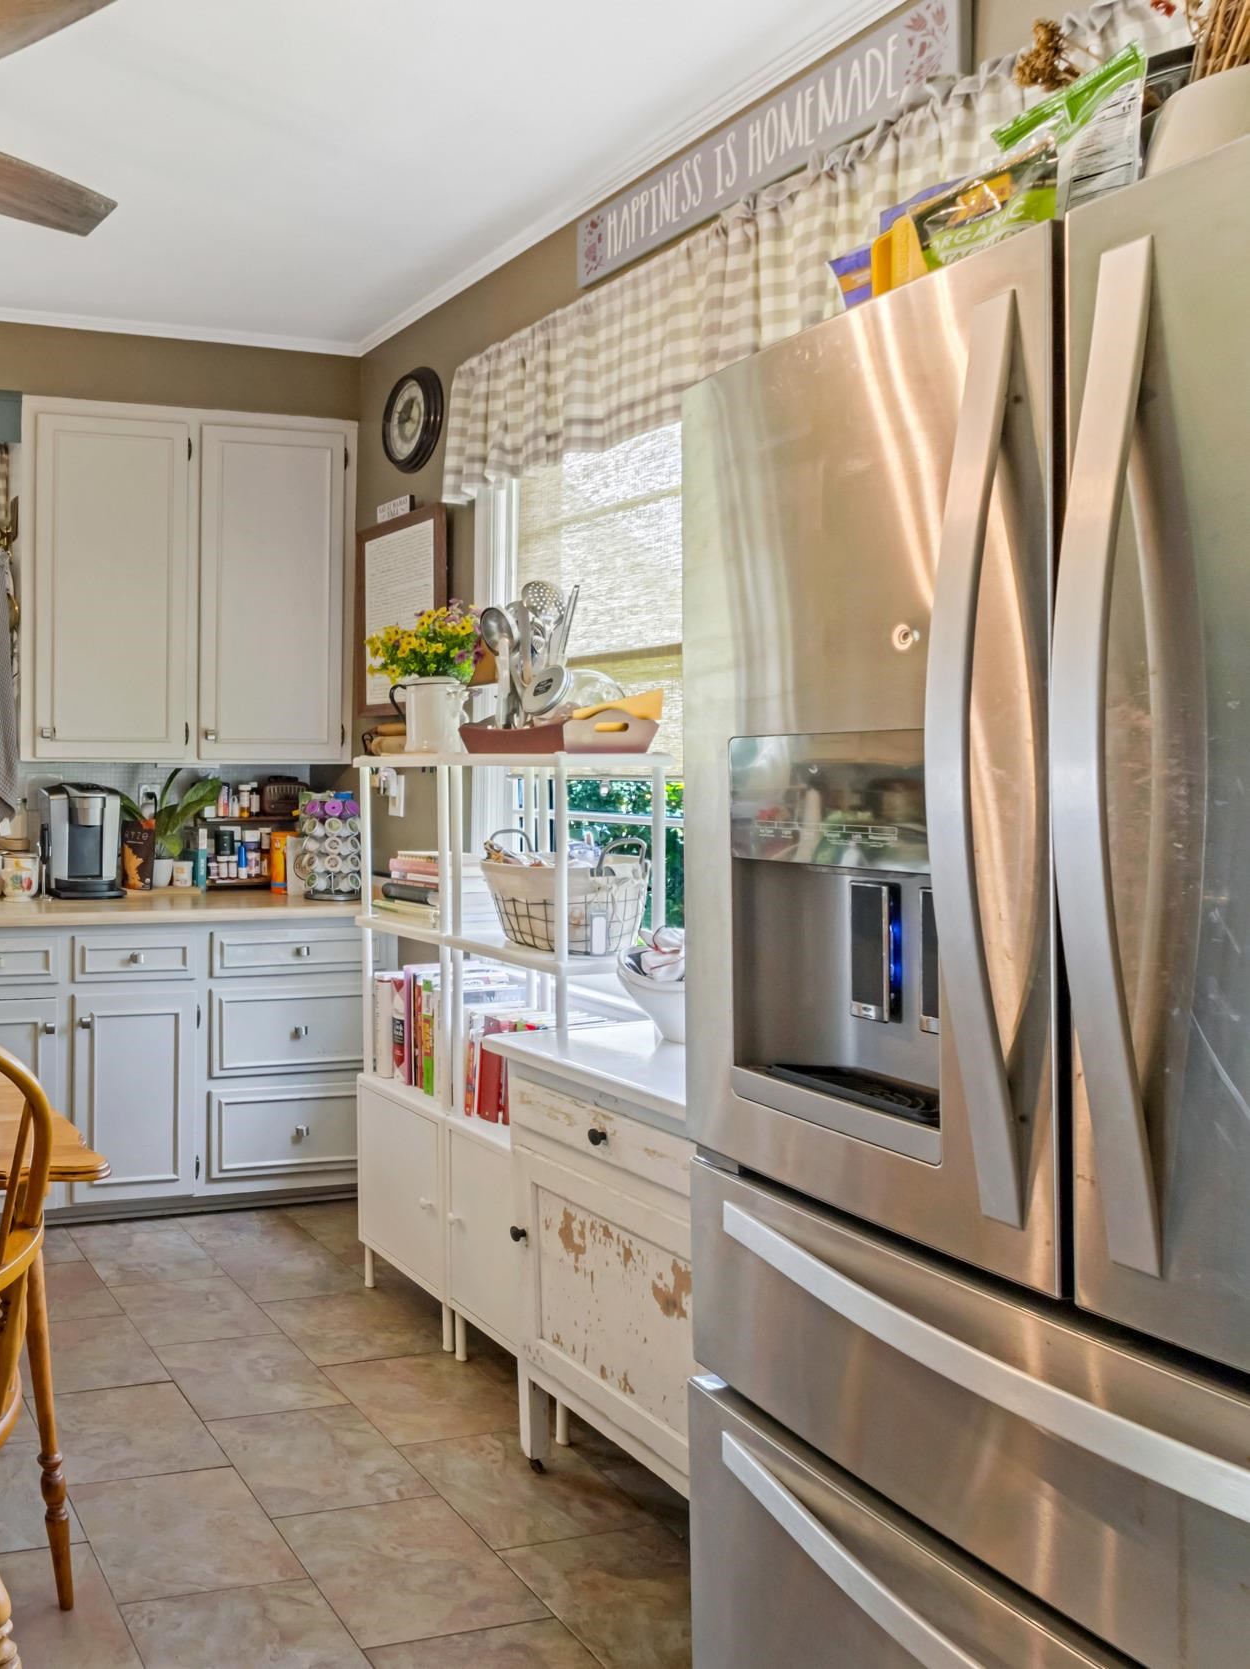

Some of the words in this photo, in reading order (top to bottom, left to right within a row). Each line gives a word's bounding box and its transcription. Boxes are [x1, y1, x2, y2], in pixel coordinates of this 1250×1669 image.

[606, 152, 703, 260] HAPPINESS
[714, 130, 737, 199] IS
[747, 33, 900, 179] HOMEMADE
